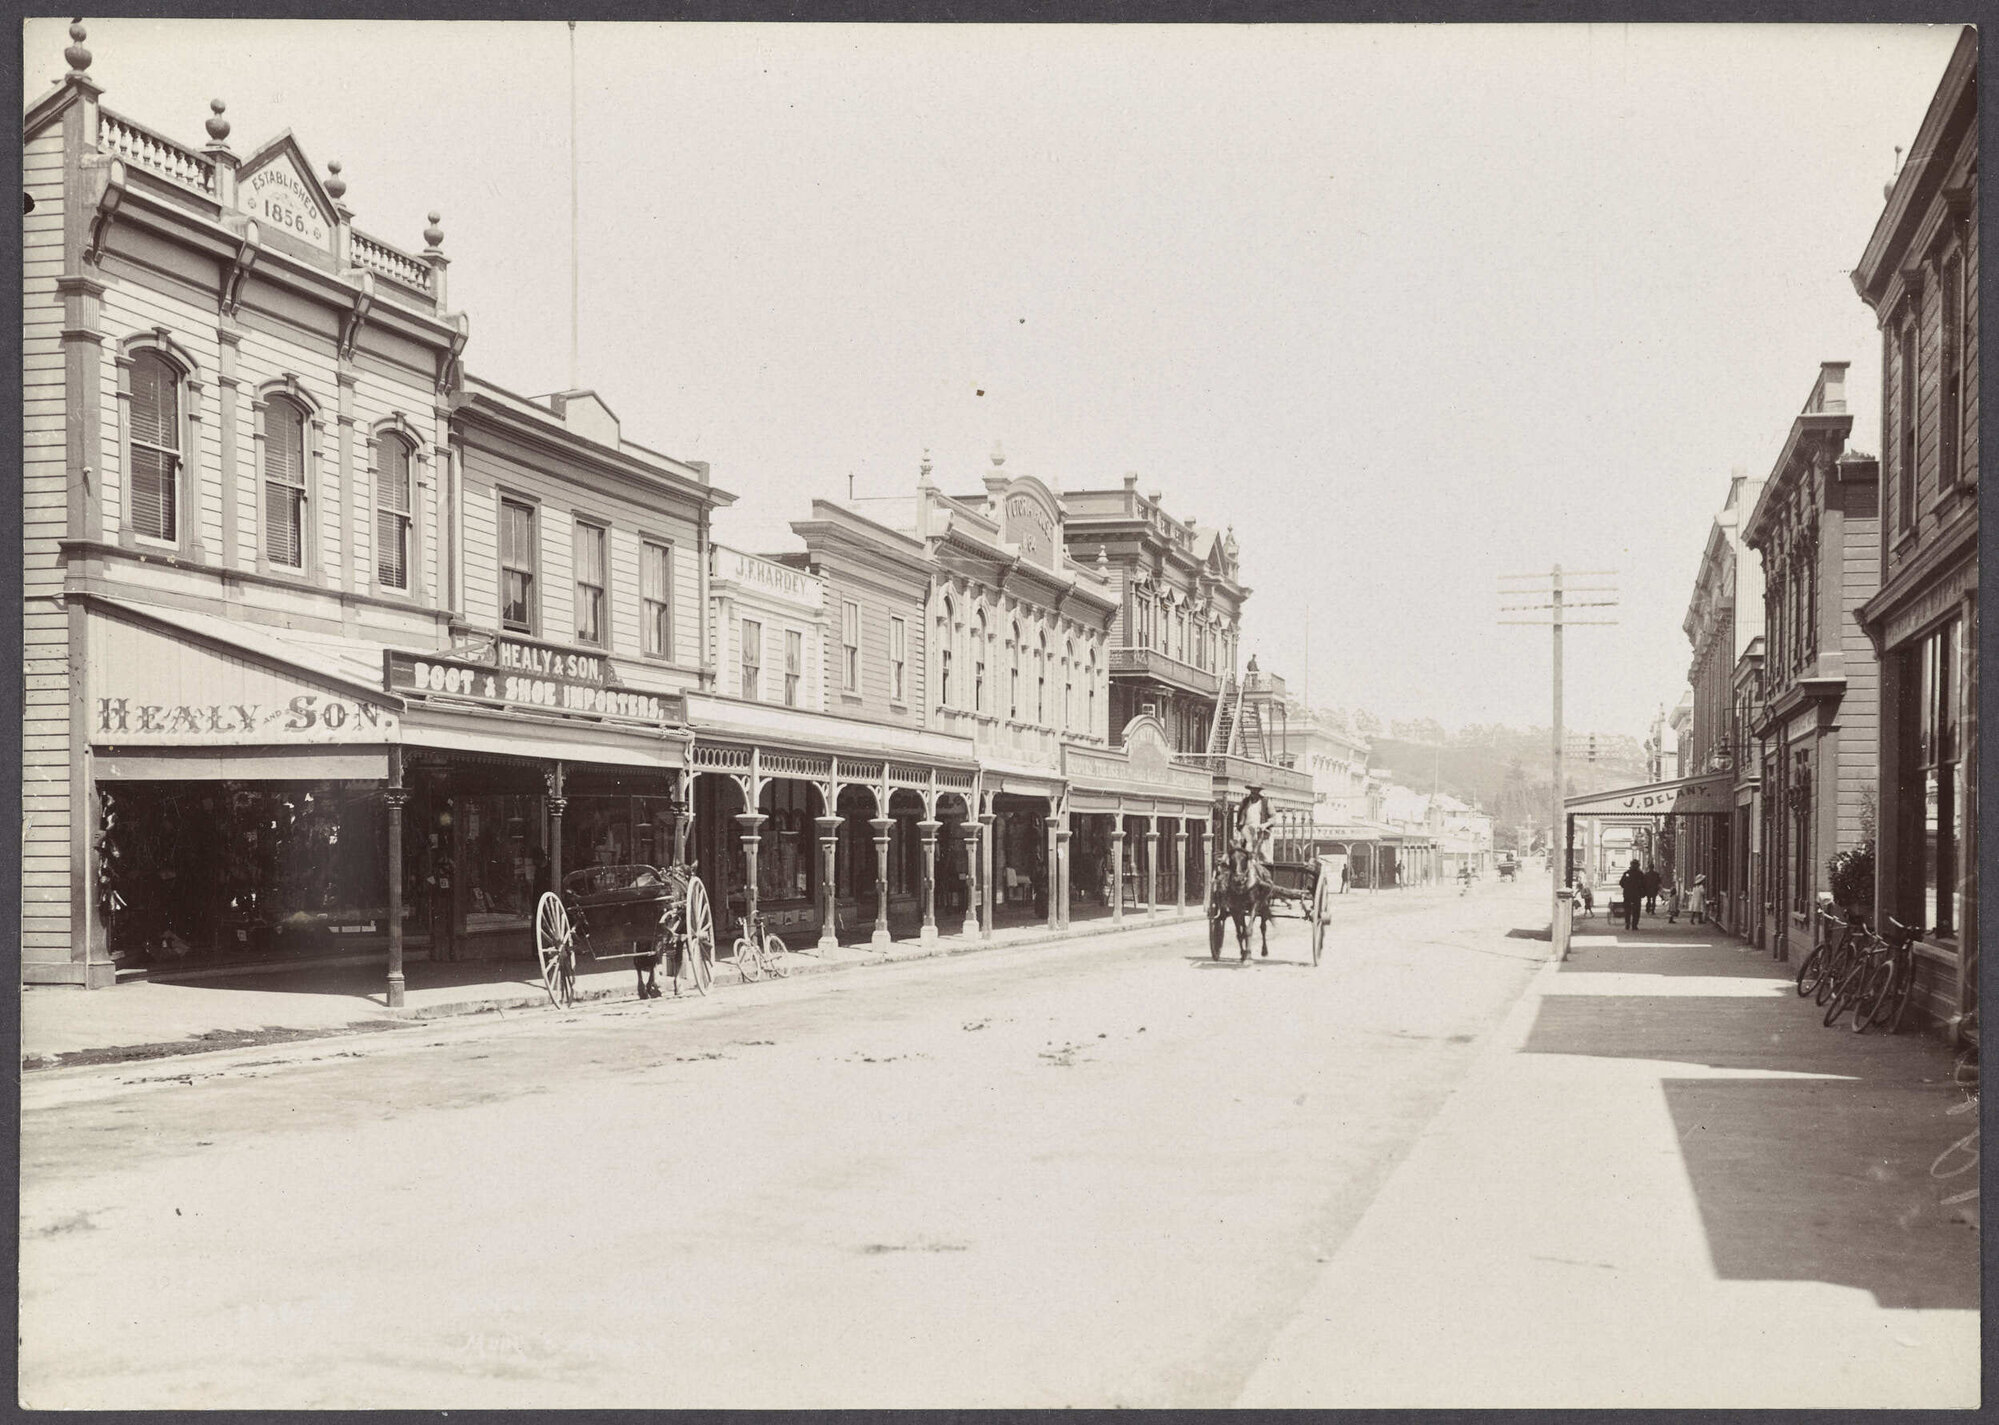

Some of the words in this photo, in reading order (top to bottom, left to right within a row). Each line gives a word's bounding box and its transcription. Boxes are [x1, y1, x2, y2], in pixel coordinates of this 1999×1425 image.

[252, 171, 317, 219] ESTABLISHED
[500, 642, 553, 674] HEALY
[553, 655, 565, 677] &
[413, 661, 475, 695] BOOT
[484, 675, 497, 699] &
[504, 676, 557, 707] SHOE
[96, 696, 262, 735] HEALY
[263, 709, 283, 725] AND
[284, 694, 394, 735] SON.
